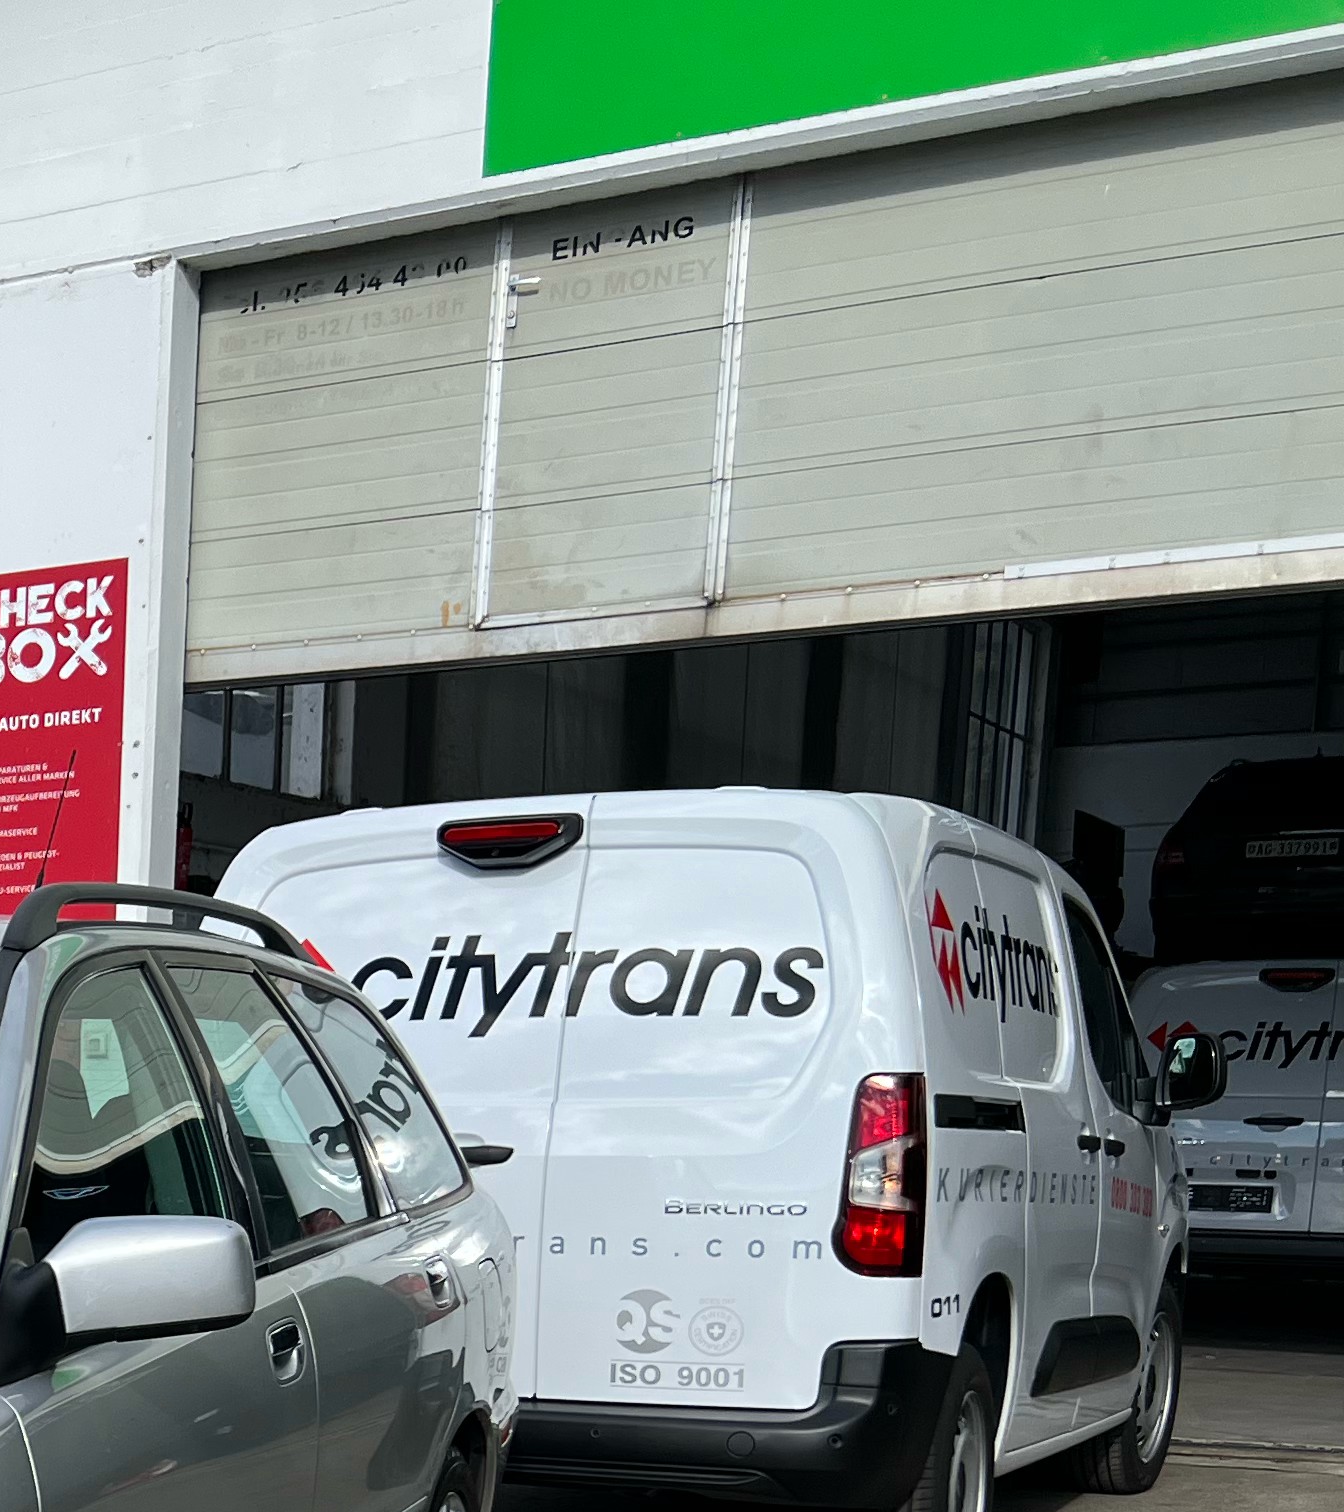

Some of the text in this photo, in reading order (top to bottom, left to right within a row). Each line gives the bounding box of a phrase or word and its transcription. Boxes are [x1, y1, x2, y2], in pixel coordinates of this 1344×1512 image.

[604, 257, 718, 297] MONEY
[44, 707, 103, 727] DIREKT
[18, 773, 42, 783] ALLER
[350, 931, 824, 1038] citytrans
[936, 1167, 1097, 1205] KURIERDIENSTE
[664, 1197, 808, 1216] BERLINGO
[931, 1293, 960, 1318] 011
[610, 1363, 745, 1389] ISO 9001
